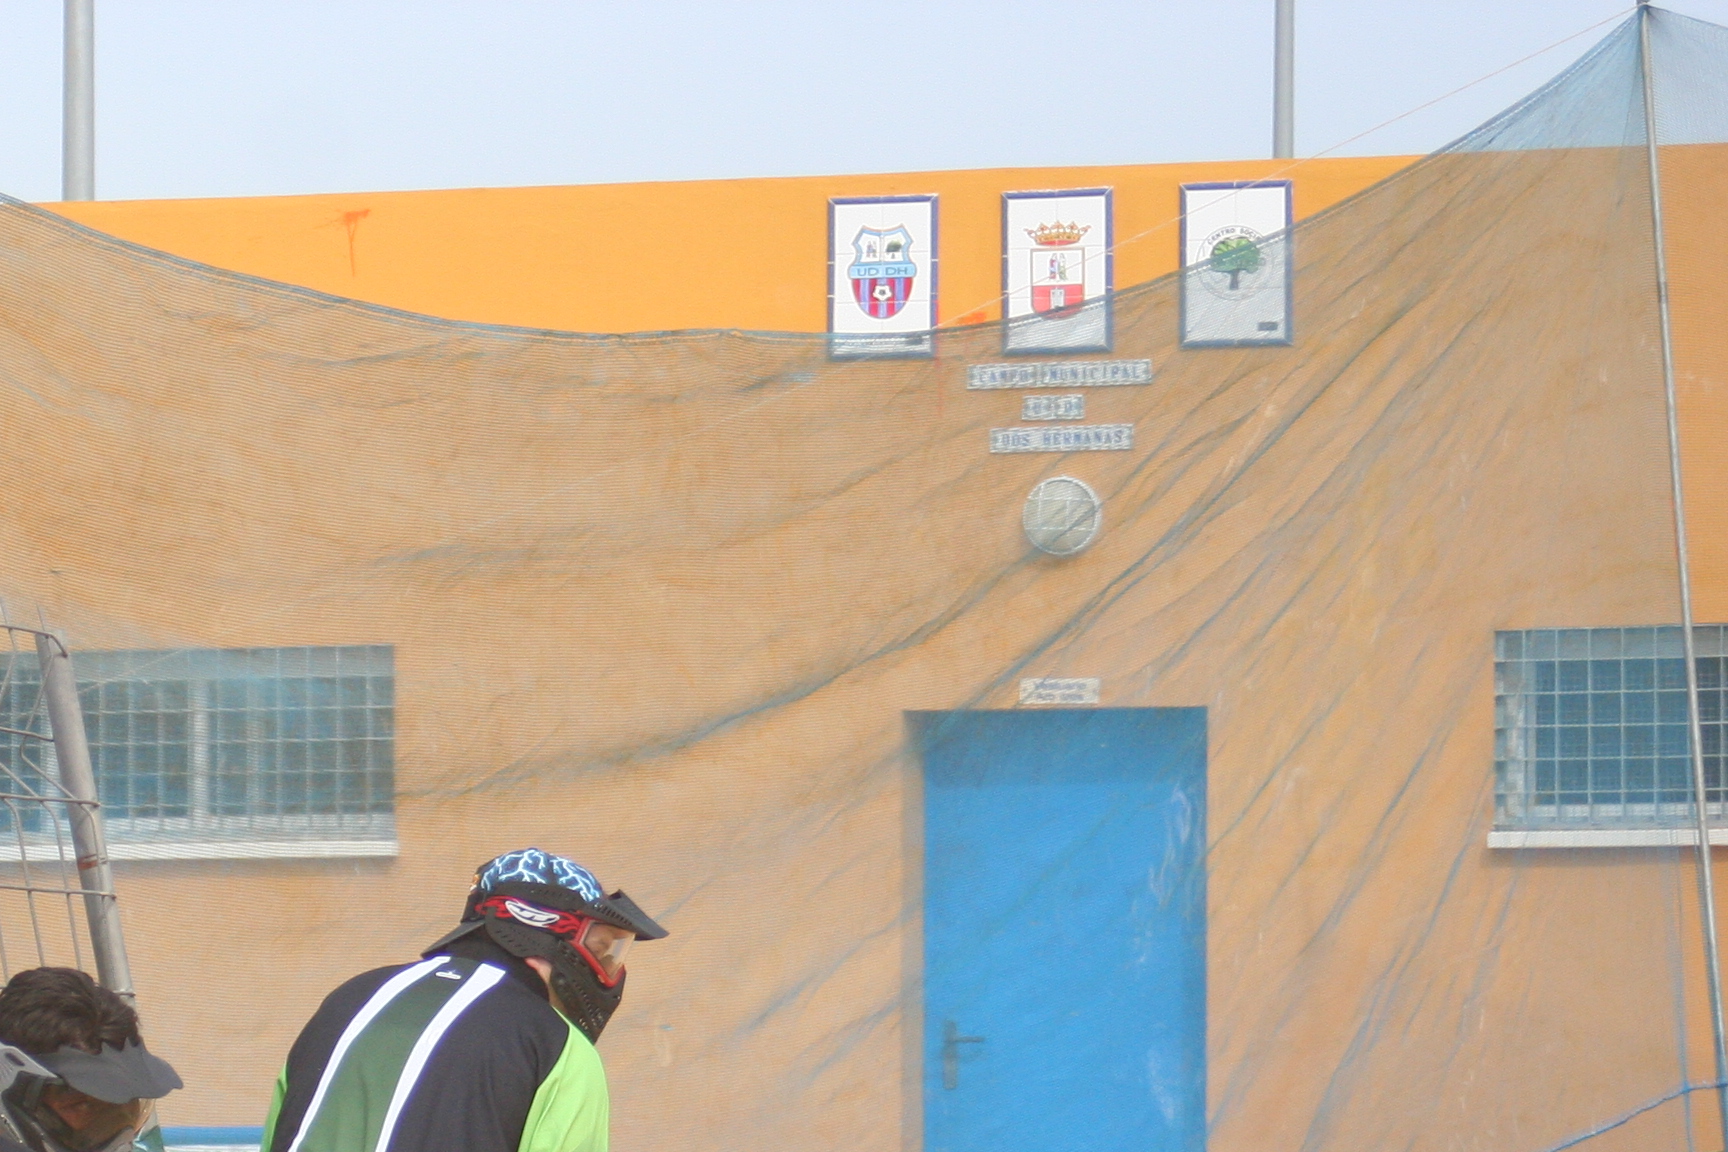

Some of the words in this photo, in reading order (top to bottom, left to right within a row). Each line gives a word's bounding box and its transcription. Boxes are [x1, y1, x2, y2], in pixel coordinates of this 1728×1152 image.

[857, 267, 879, 277] UD
[885, 266, 908, 276] DH
[1048, 365, 1140, 381] MUNICIPAL
[1042, 429, 1123, 446] HERMANAS
